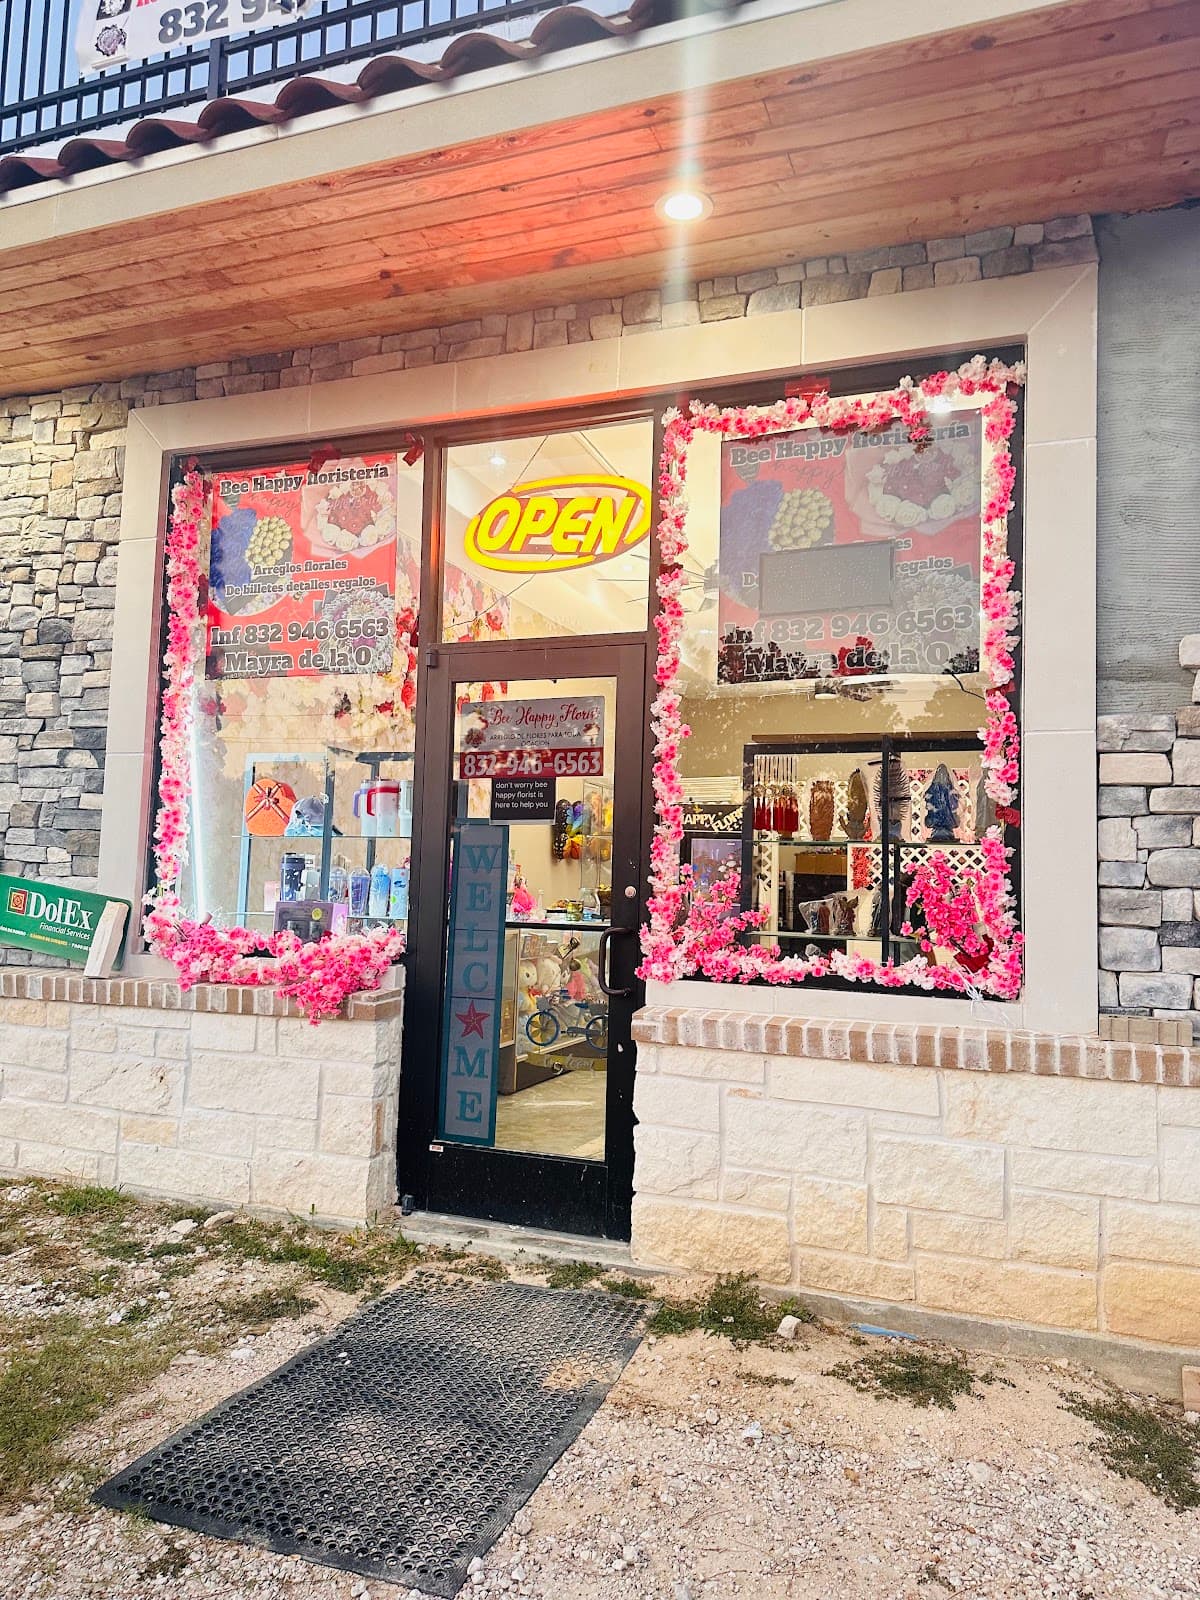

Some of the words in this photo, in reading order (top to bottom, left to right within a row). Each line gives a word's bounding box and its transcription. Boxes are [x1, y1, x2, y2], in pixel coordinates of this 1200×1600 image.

[158, 0, 229, 44] 832
[731, 445, 771, 467] Bee
[775, 438, 847, 461] Happy
[852, 422, 970, 449] florisría
[219, 480, 250, 496] Bee
[252, 473, 304, 494] Happy
[475, 495, 637, 555] OPEN
[253, 564, 302, 577] Arreglos
[304, 560, 348, 573] florales
[286, 577, 331, 593] detalles
[333, 575, 377, 592] regalos
[210, 627, 242, 645] Inf
[244, 622, 283, 644] 832
[287, 620, 331, 640] 946
[334, 617, 390, 640] 6563
[769, 618, 825, 642] 832
[830, 611, 890, 637] 946
[896, 605, 974, 635] 6563
[223, 651, 294, 675] Mayra
[297, 648, 323, 668] de
[325, 647, 351, 666] la
[845, 646, 884, 668] de
[889, 642, 918, 665] la
[492, 709, 511, 726] Bee
[515, 706, 558, 729] Happy
[496, 781, 513, 789] don't
[514, 782, 533, 791] worry
[496, 792, 515, 802] happy
[520, 801, 534, 810] help
[536, 802, 548, 810] you
[27, 891, 94, 931] DolEx
[40, 922, 66, 934] Financial
[66, 927, 91, 940] Services
